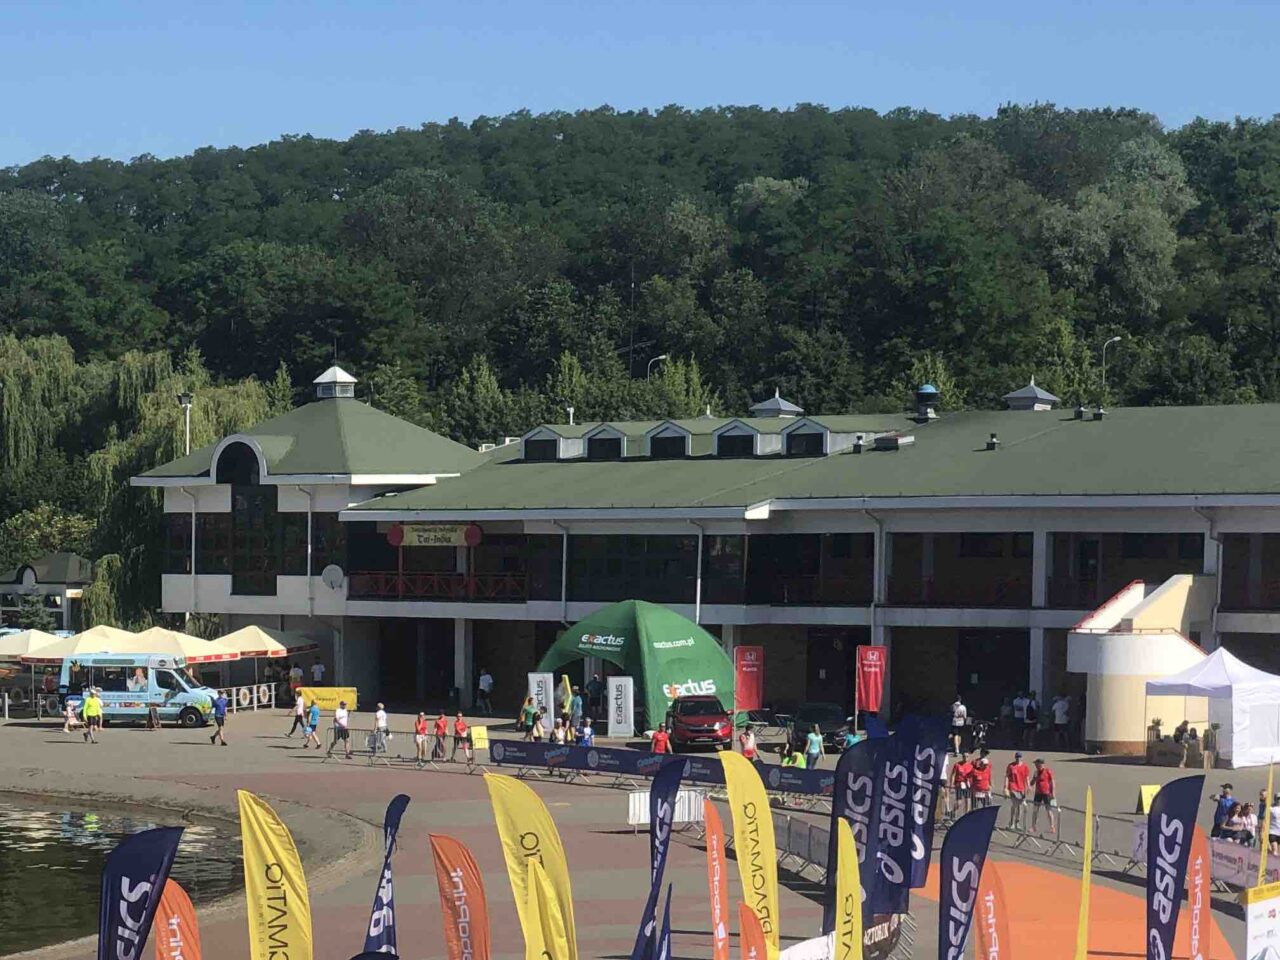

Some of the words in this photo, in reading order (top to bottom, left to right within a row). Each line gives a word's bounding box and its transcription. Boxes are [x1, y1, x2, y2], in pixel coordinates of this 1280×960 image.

[581, 633, 624, 646] exactus
[663, 678, 717, 697] exactus
[878, 761, 909, 847] asics
[1152, 813, 1184, 924] asics
